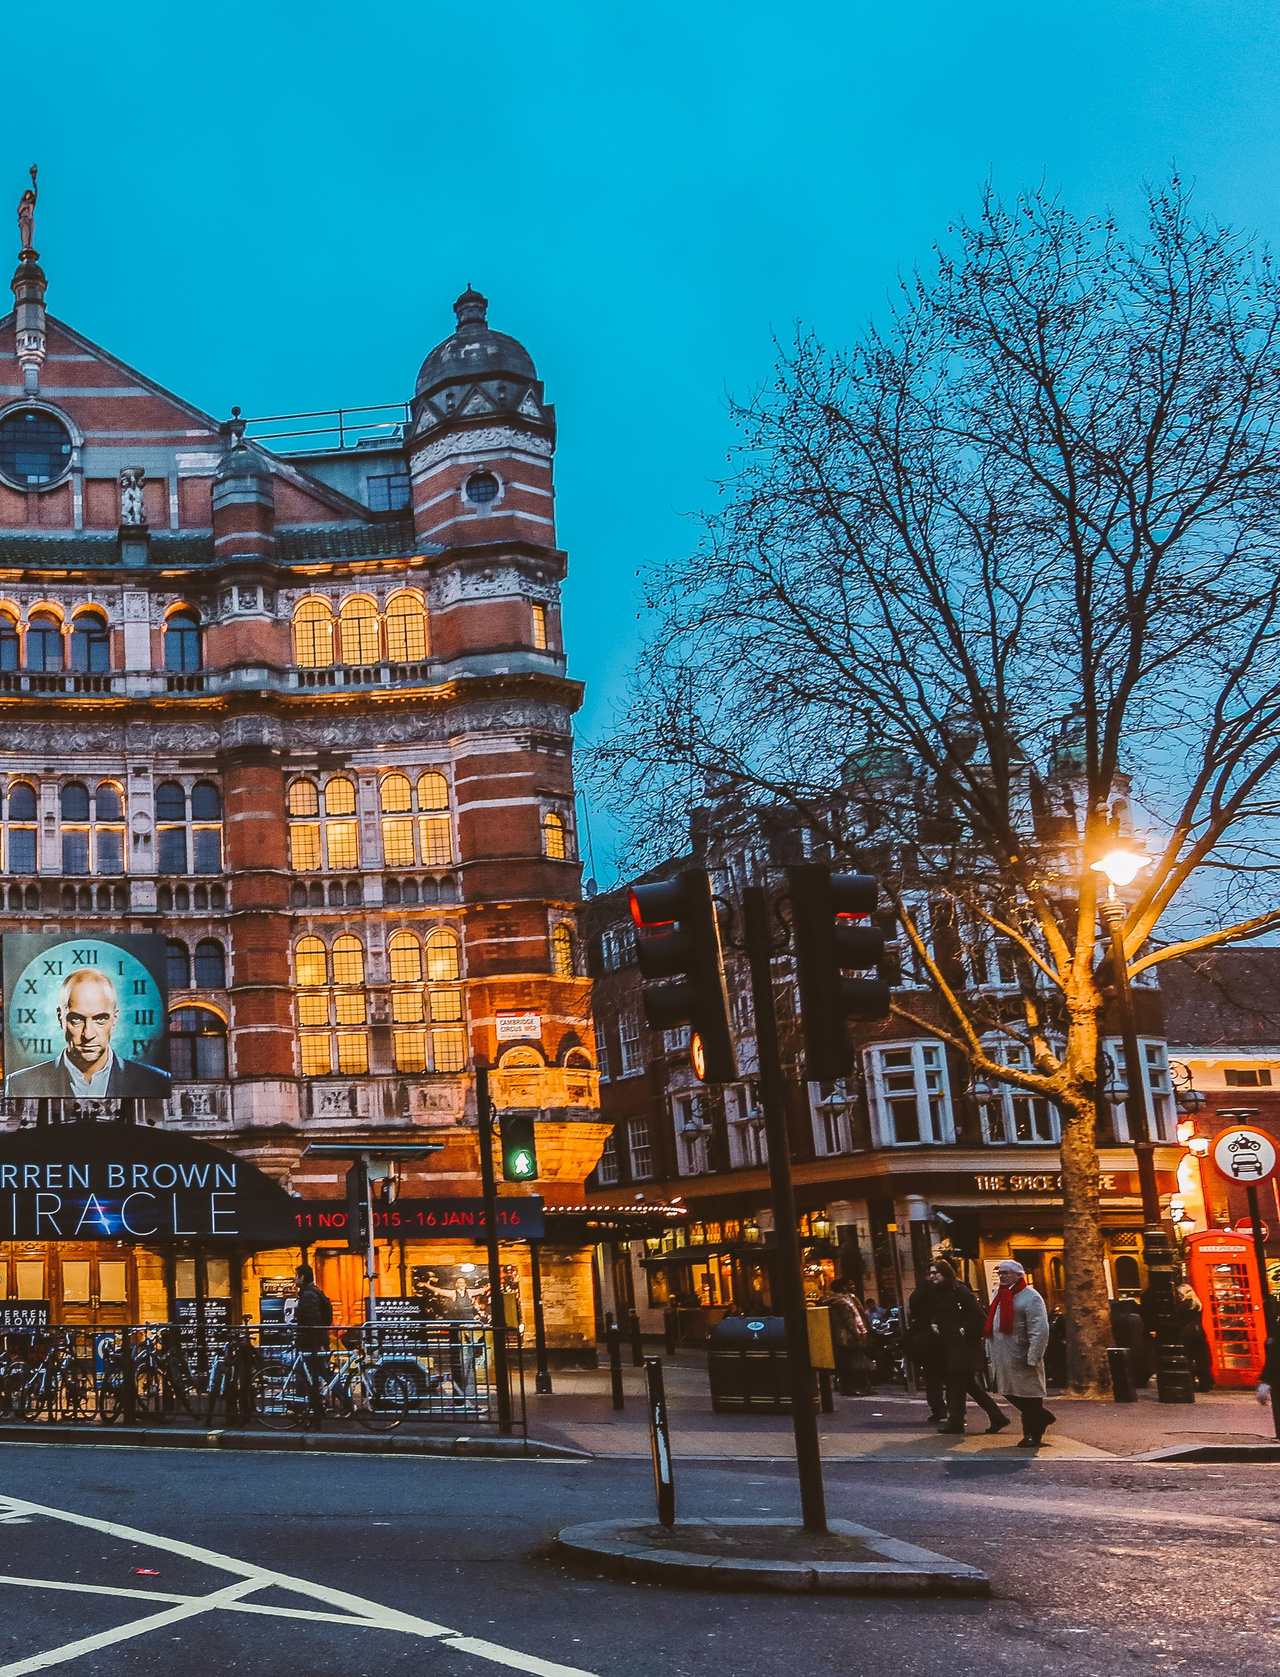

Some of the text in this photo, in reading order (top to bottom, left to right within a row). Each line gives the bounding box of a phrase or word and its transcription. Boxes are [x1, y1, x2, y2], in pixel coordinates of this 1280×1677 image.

[72, 950, 98, 965] XII
[43, 961, 63, 976] XI
[118, 961, 124, 975] I
[24, 979, 38, 994] X
[133, 980, 146, 995] II
[17, 1009, 37, 1024] IX
[135, 1010, 155, 1026] III
[19, 1038, 52, 1054] VIII
[107, 1163, 237, 1188] BROWN
[974, 1175, 1007, 1191] THE
[1009, 1175, 1055, 1191] SPICE
[294, 1214, 313, 1228] 11
[371, 1212, 401, 1226] 015
[419, 1212, 436, 1226] 16
[440, 1212, 474, 1226] JAN
[478, 1210, 521, 1225] 216
